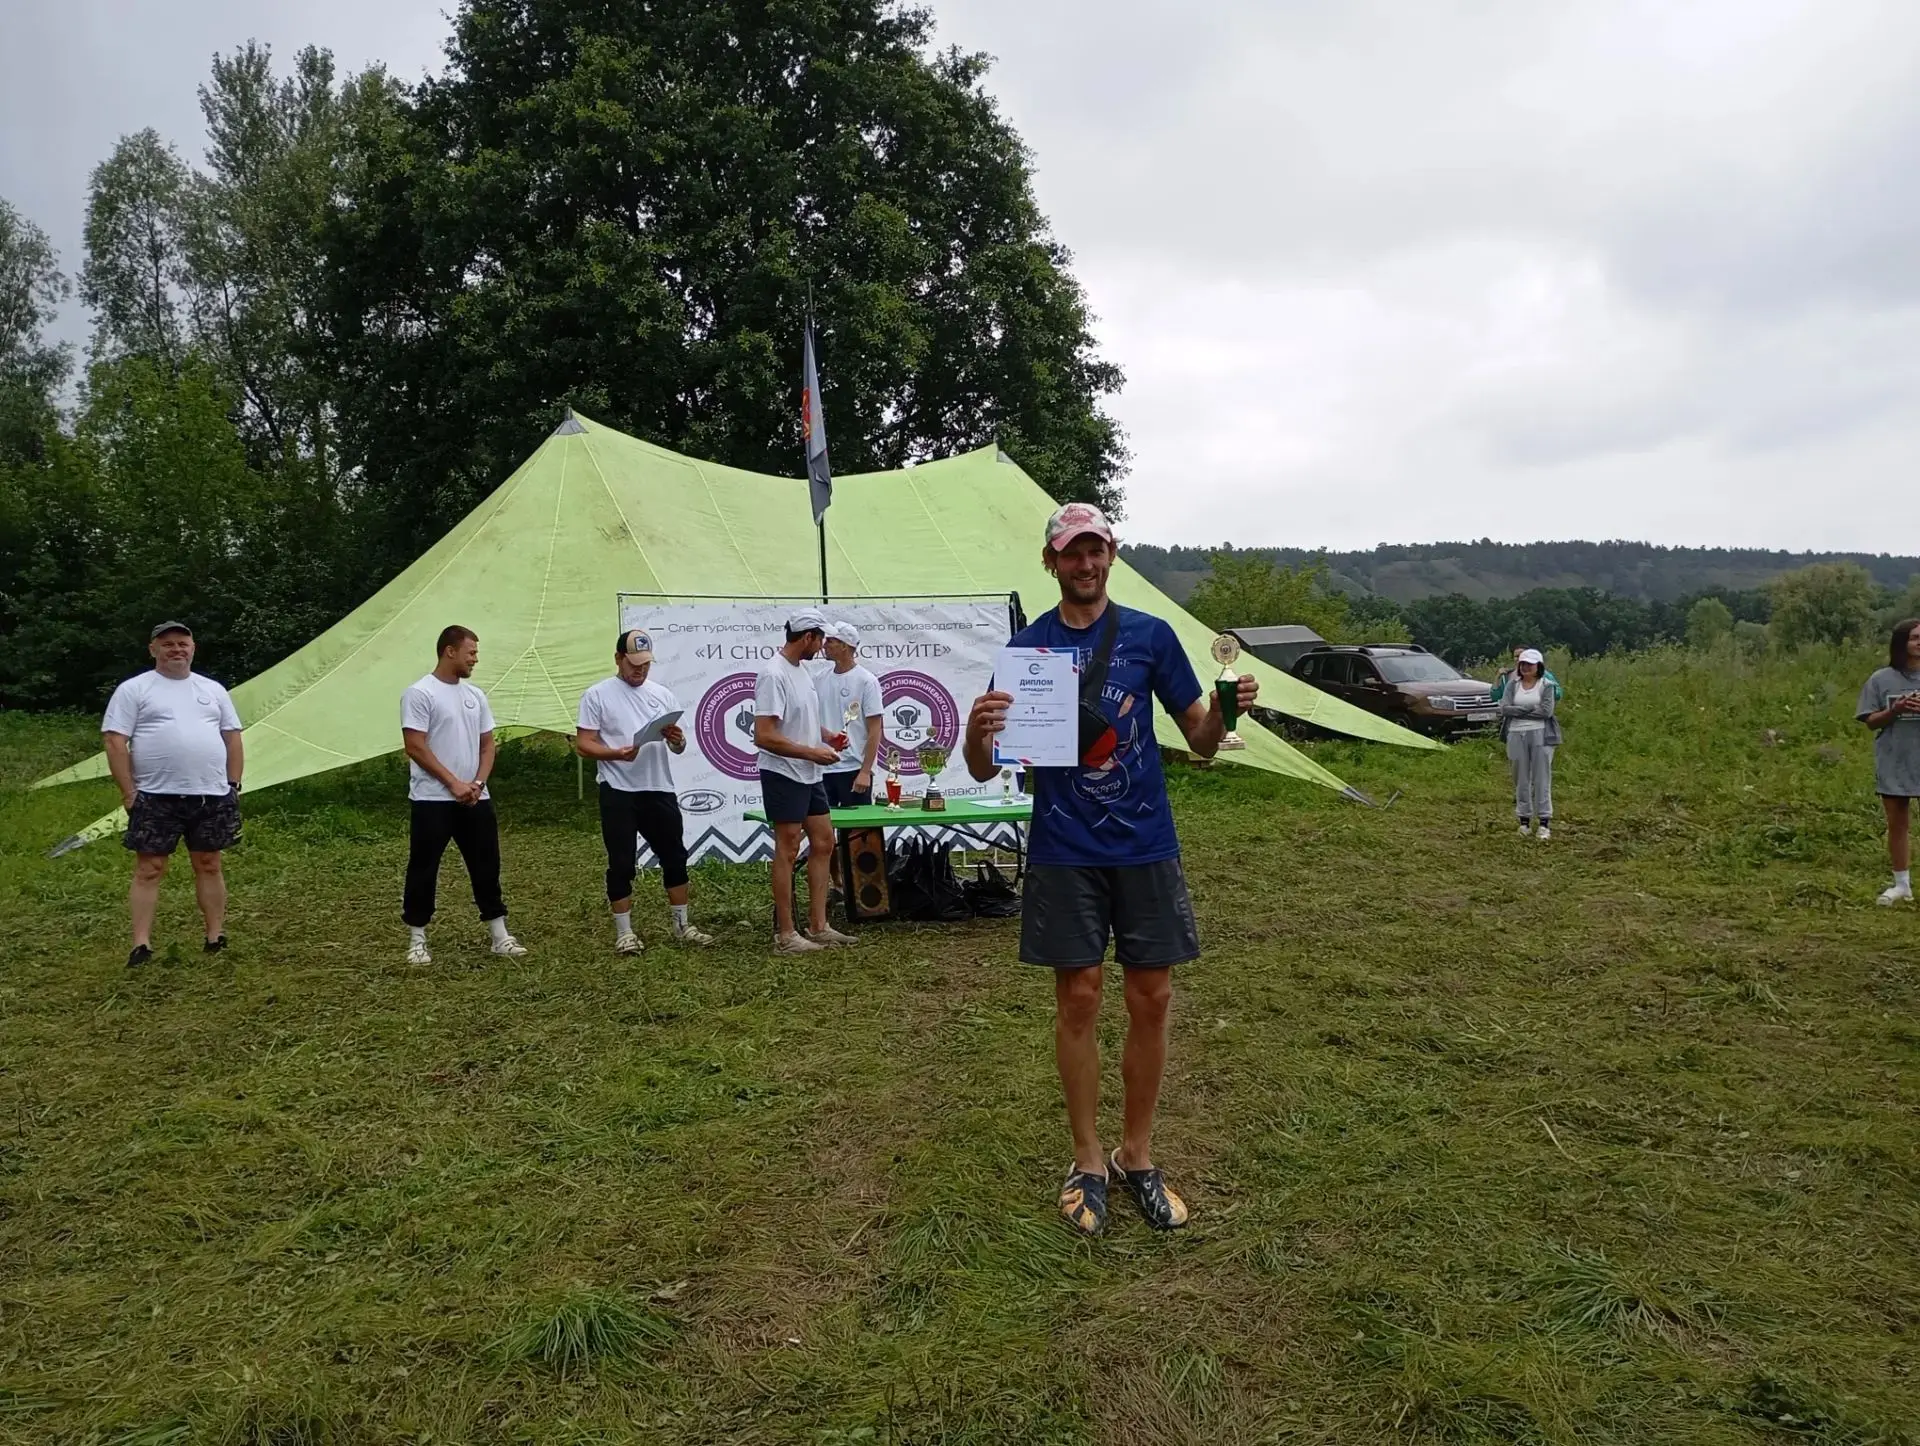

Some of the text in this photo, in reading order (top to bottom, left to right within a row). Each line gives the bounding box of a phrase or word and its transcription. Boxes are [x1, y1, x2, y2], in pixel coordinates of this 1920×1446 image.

[702, 624, 761, 635] туристов
[887, 622, 973, 632] производства
[1019, 679, 1054, 687] ДИПЛОМ
[891, 679, 948, 711] АЛЮМИНИЕВОГО
[703, 681, 744, 733] ПРОИЗВОДСТВО
[1030, 706, 1035, 714] 1
